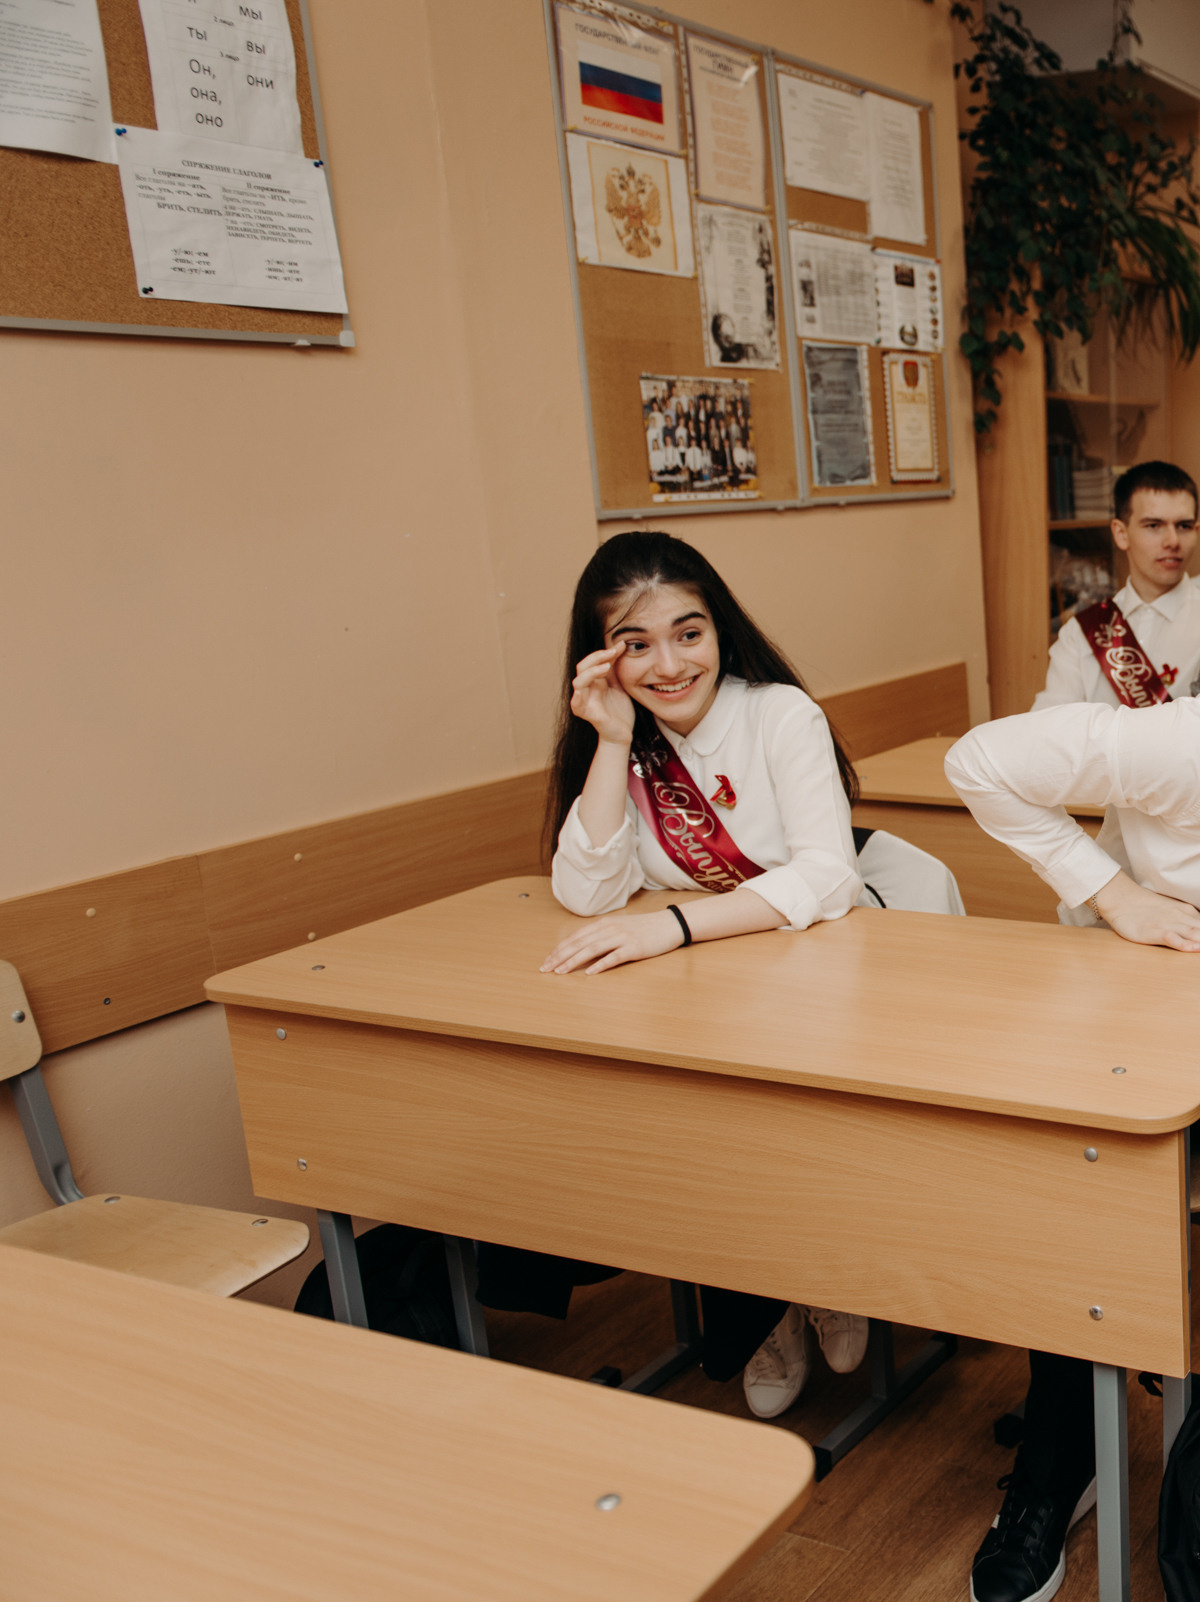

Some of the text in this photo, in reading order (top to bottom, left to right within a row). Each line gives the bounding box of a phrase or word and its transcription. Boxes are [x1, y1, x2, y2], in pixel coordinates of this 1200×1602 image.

[239, 5, 263, 20] мы
[186, 26, 208, 41] ты
[246, 41, 266, 55] вы
[189, 58, 216, 80] Он,
[246, 74, 274, 90] они
[190, 87, 222, 106] она,
[195, 112, 224, 128] оно
[181, 159, 231, 174] СПРЯЖЕНИЕ
